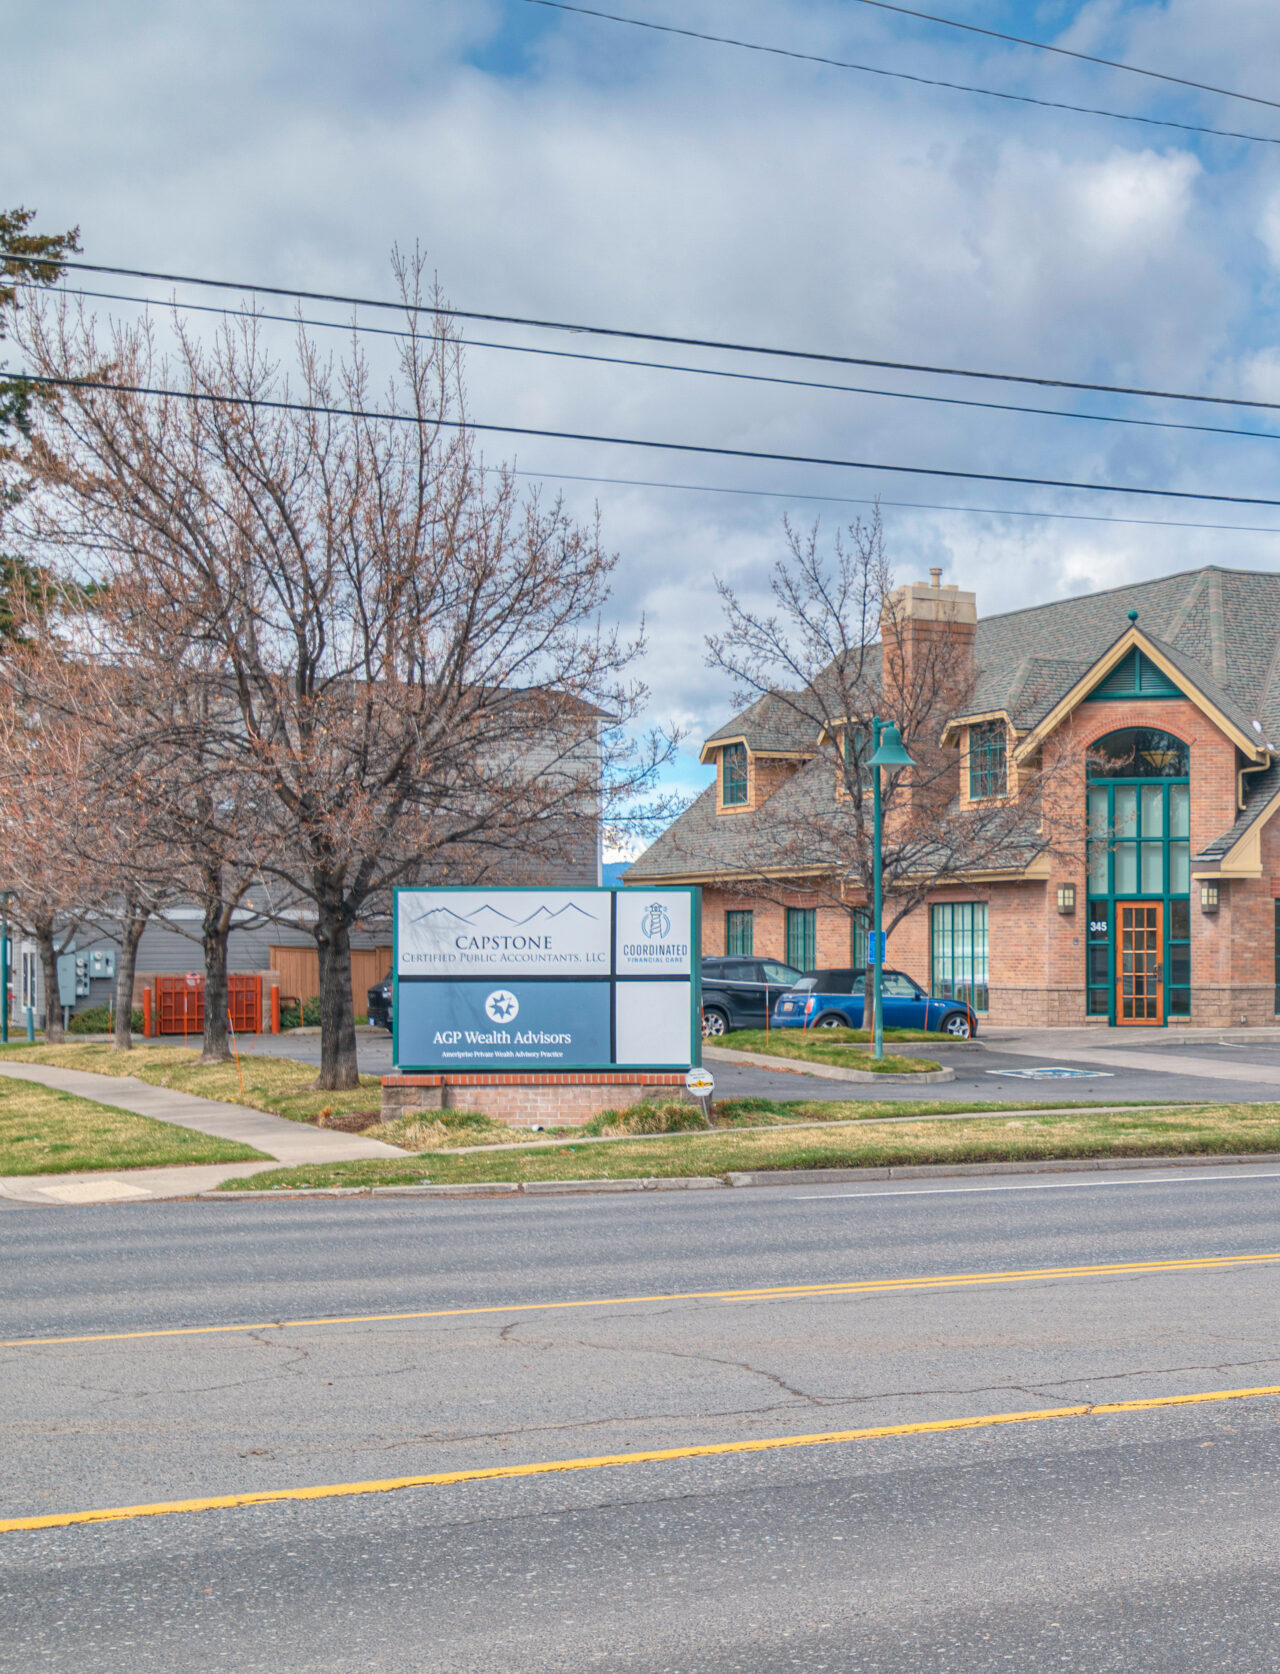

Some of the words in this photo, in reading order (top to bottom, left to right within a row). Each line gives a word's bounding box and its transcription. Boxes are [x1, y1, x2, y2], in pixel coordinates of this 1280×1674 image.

[1090, 922, 1107, 931] 345
[455, 936, 552, 950] CAPSTONE
[623, 944, 688, 956] COORDINATED
[402, 953, 456, 962] CERTIFIED
[460, 953, 496, 962] PUBLIC
[500, 953, 581, 963] ACCOUNTANTS,
[586, 953, 606, 962] LLC
[433, 1031, 462, 1044] AGP
[464, 1030, 511, 1044] Wealth
[514, 1031, 572, 1044] Advisors
